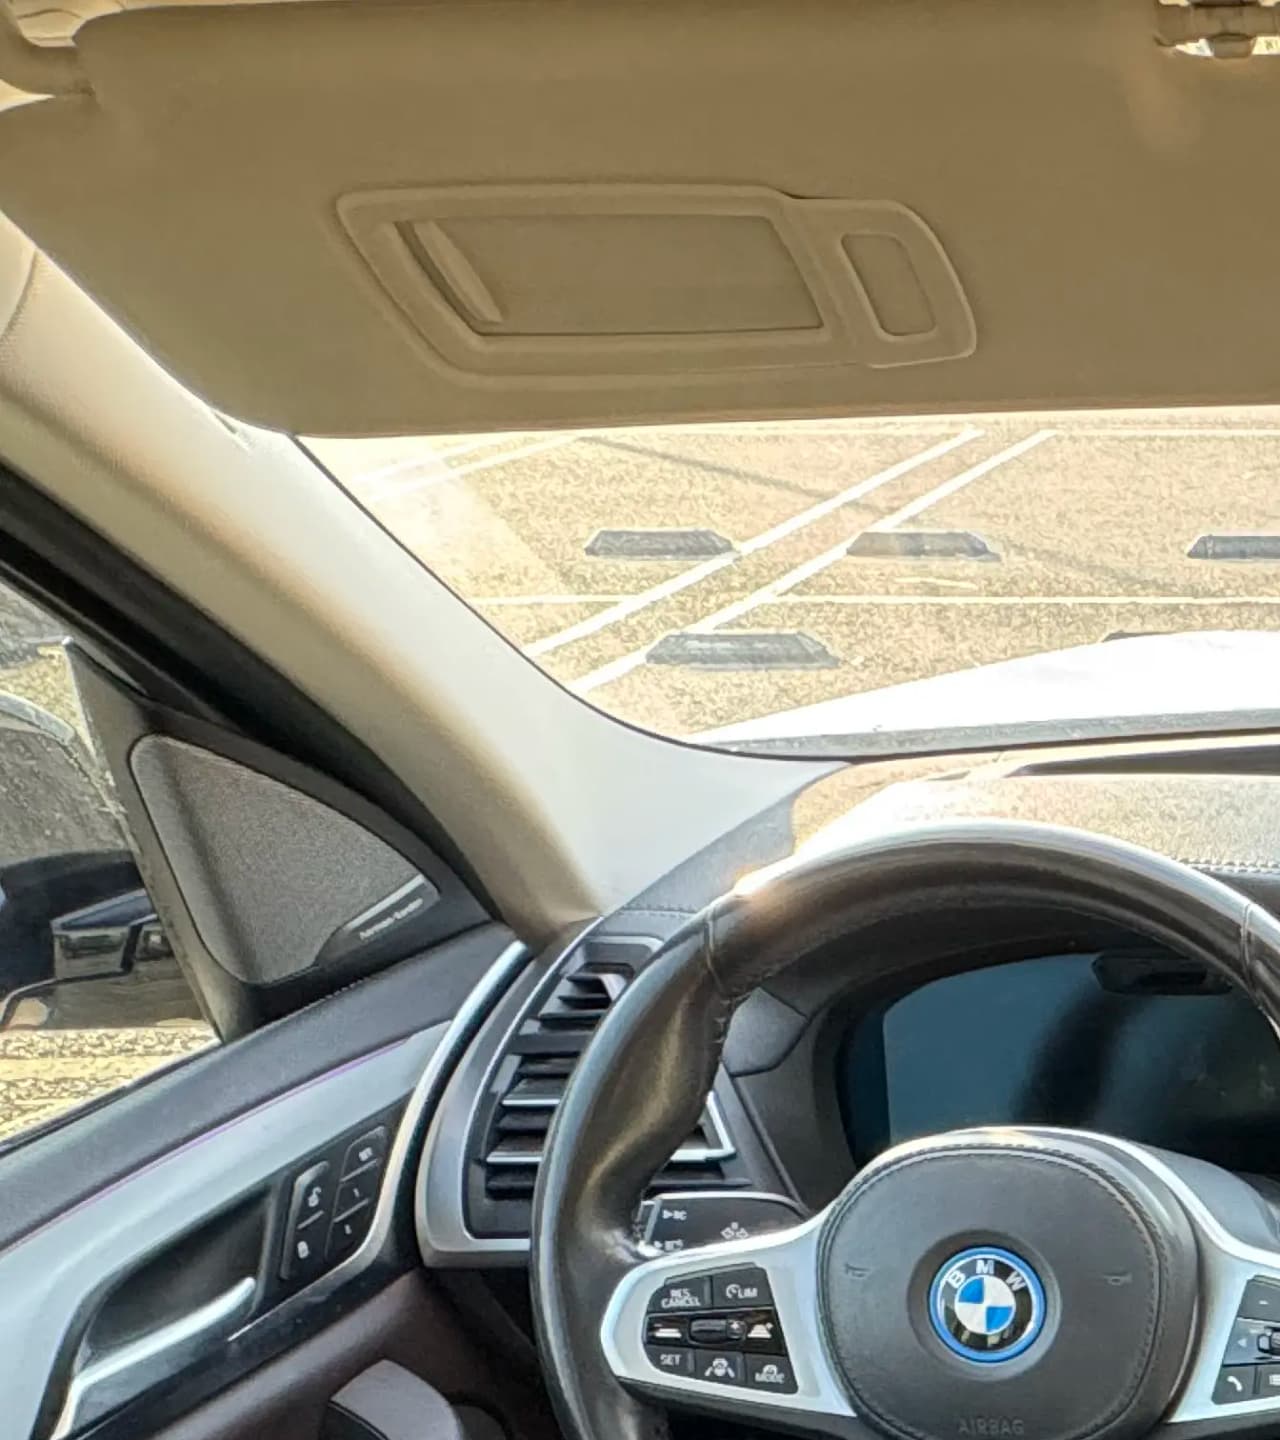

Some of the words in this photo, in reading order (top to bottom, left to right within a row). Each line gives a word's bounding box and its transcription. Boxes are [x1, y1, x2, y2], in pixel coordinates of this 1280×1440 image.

[947, 1259, 1027, 1292] BMW
[660, 1296, 701, 1309] CANCEL
[659, 1353, 682, 1366] SET
[958, 1416, 1025, 1437] AIRBAG
